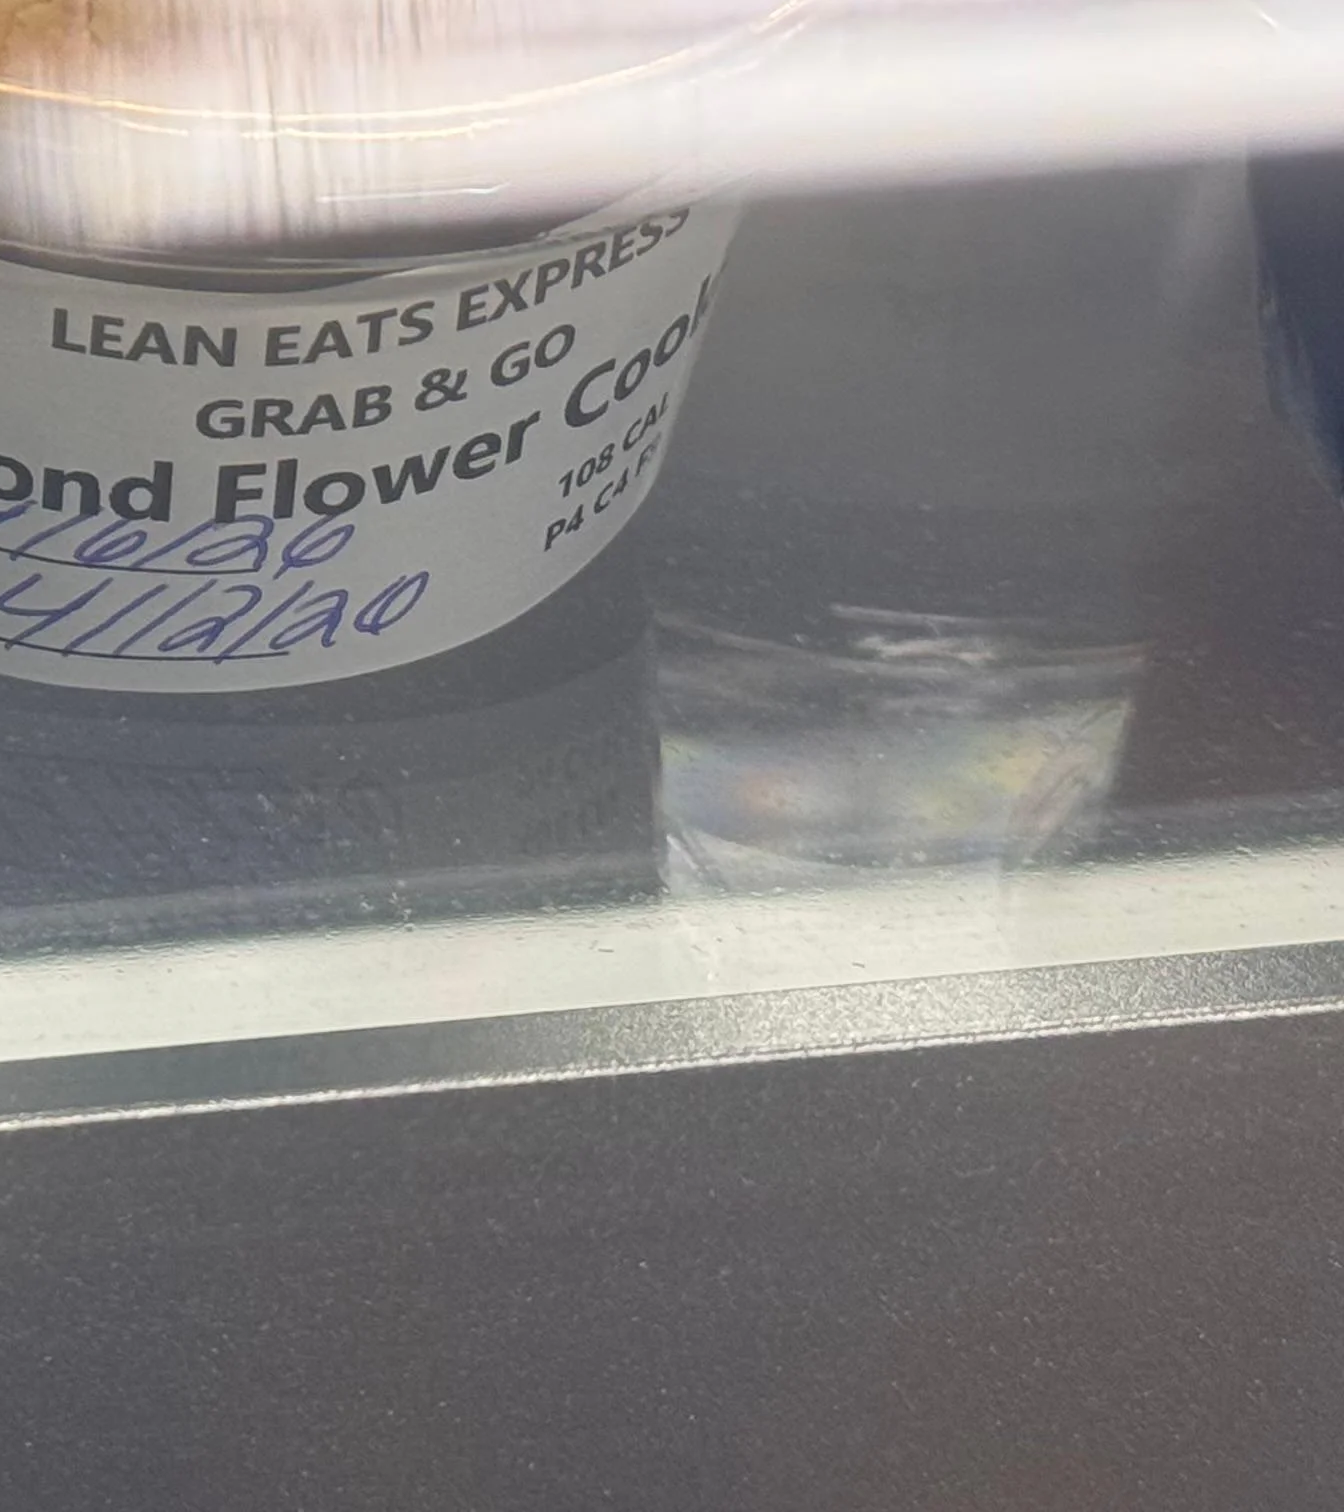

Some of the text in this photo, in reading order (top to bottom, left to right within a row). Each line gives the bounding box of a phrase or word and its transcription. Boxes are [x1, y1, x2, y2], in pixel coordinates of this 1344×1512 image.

[50, 207, 691, 368] LEAN EATS EXPRESS
[196, 323, 577, 440] GRAB & GO
[213, 409, 542, 524] Flower
[558, 443, 615, 498] 108
[543, 504, 585, 552] P4
